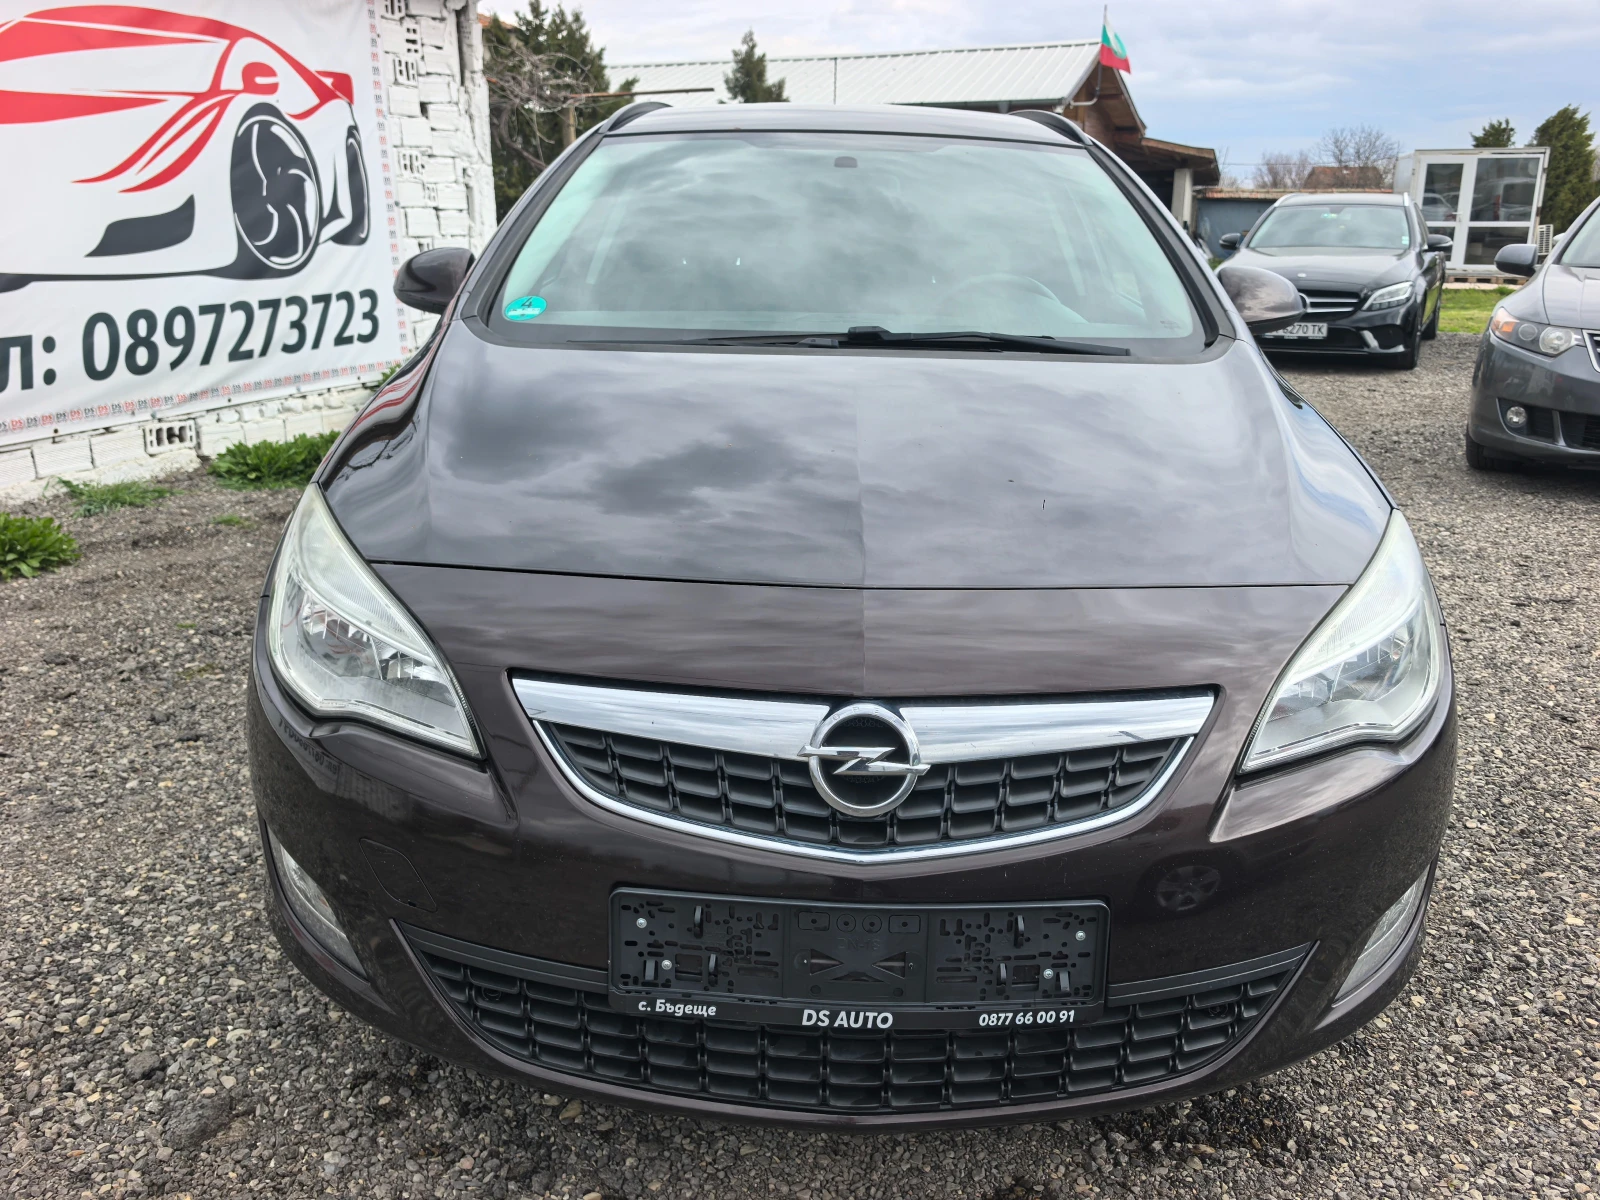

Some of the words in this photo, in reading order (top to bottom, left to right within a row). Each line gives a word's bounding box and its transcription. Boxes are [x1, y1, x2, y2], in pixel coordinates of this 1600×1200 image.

[521, 296, 533, 308] 4
[82, 288, 380, 382] 0897273723
[1311, 324, 1324, 335] TK
[638, 1001, 651, 1011] с.
[655, 998, 717, 1017] Бъдеще
[802, 1009, 830, 1027] DS
[834, 1011, 893, 1029] AUTO
[979, 1013, 1013, 1027] 0877
[1015, 1012, 1033, 1025] 66
[1036, 1010, 1056, 1024] 00
[1059, 1009, 1075, 1023] 91
